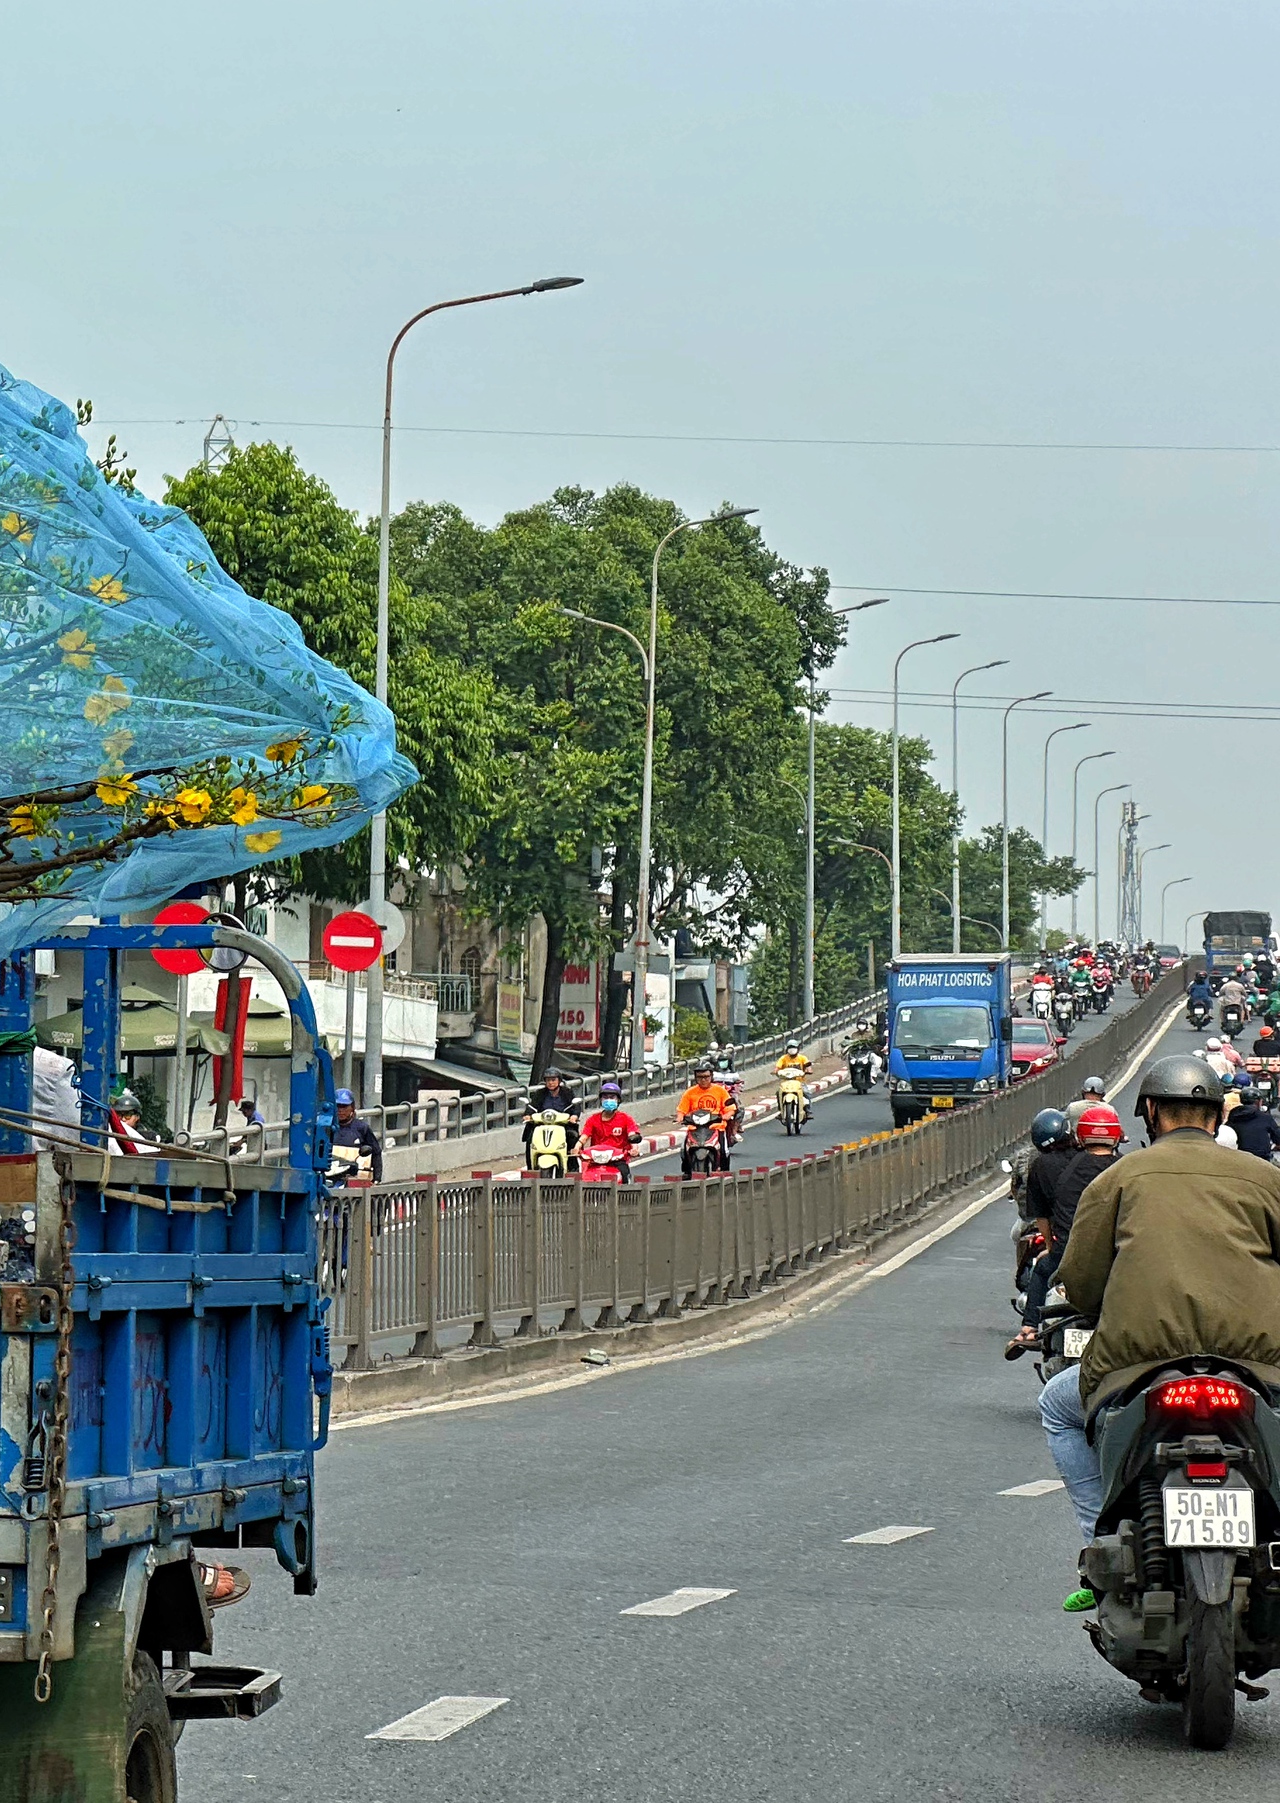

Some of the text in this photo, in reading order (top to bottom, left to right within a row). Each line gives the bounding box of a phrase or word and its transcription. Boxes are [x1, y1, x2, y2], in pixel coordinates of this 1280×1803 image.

[897, 972, 993, 987] HOA PHAT LOGISTICS
[561, 1009, 585, 1026] 150
[1178, 1492, 1238, 1517] 50-N1
[1170, 1519, 1250, 1544] 715.89
